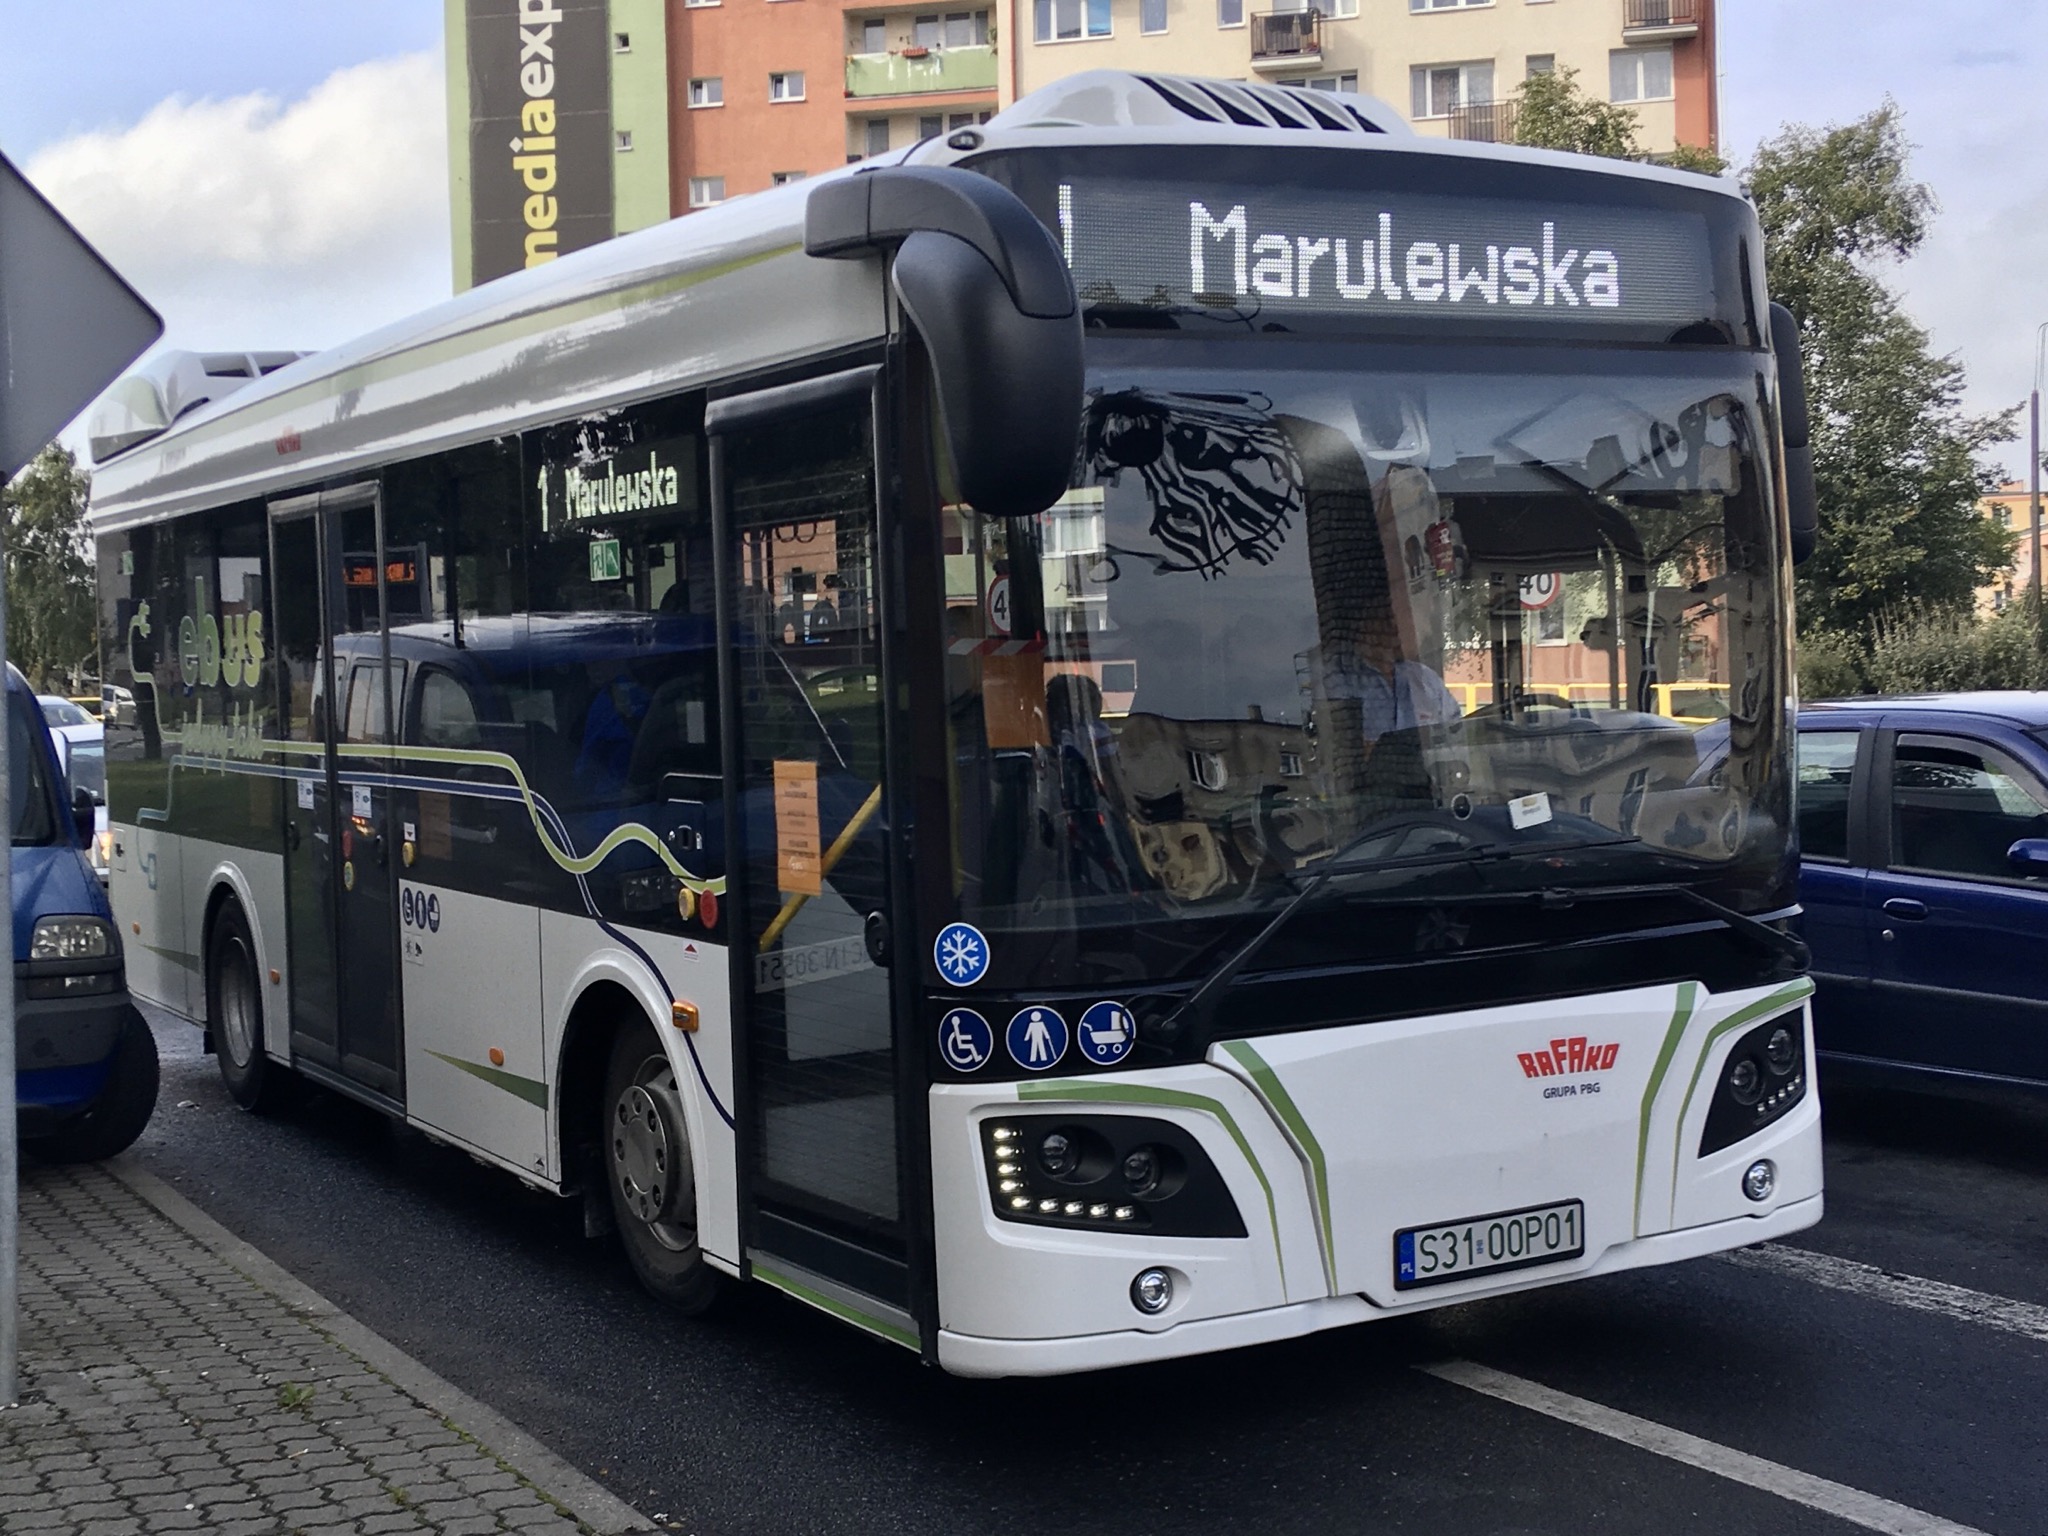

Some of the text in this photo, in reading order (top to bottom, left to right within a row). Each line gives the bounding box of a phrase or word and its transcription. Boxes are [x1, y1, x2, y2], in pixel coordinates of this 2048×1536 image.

[1190, 202, 1619, 307] Marulewska
[537, 450, 678, 532] 1 Marulewska
[1519, 572, 1552, 595] 40
[994, 590, 1007, 620] 4
[179, 576, 265, 687] ebus
[1517, 1036, 1620, 1078] RAFAKO
[1543, 1082, 1601, 1099] GRUPA PBG
[1401, 1261, 1413, 1274] PL
[1420, 1227, 1473, 1273] S31
